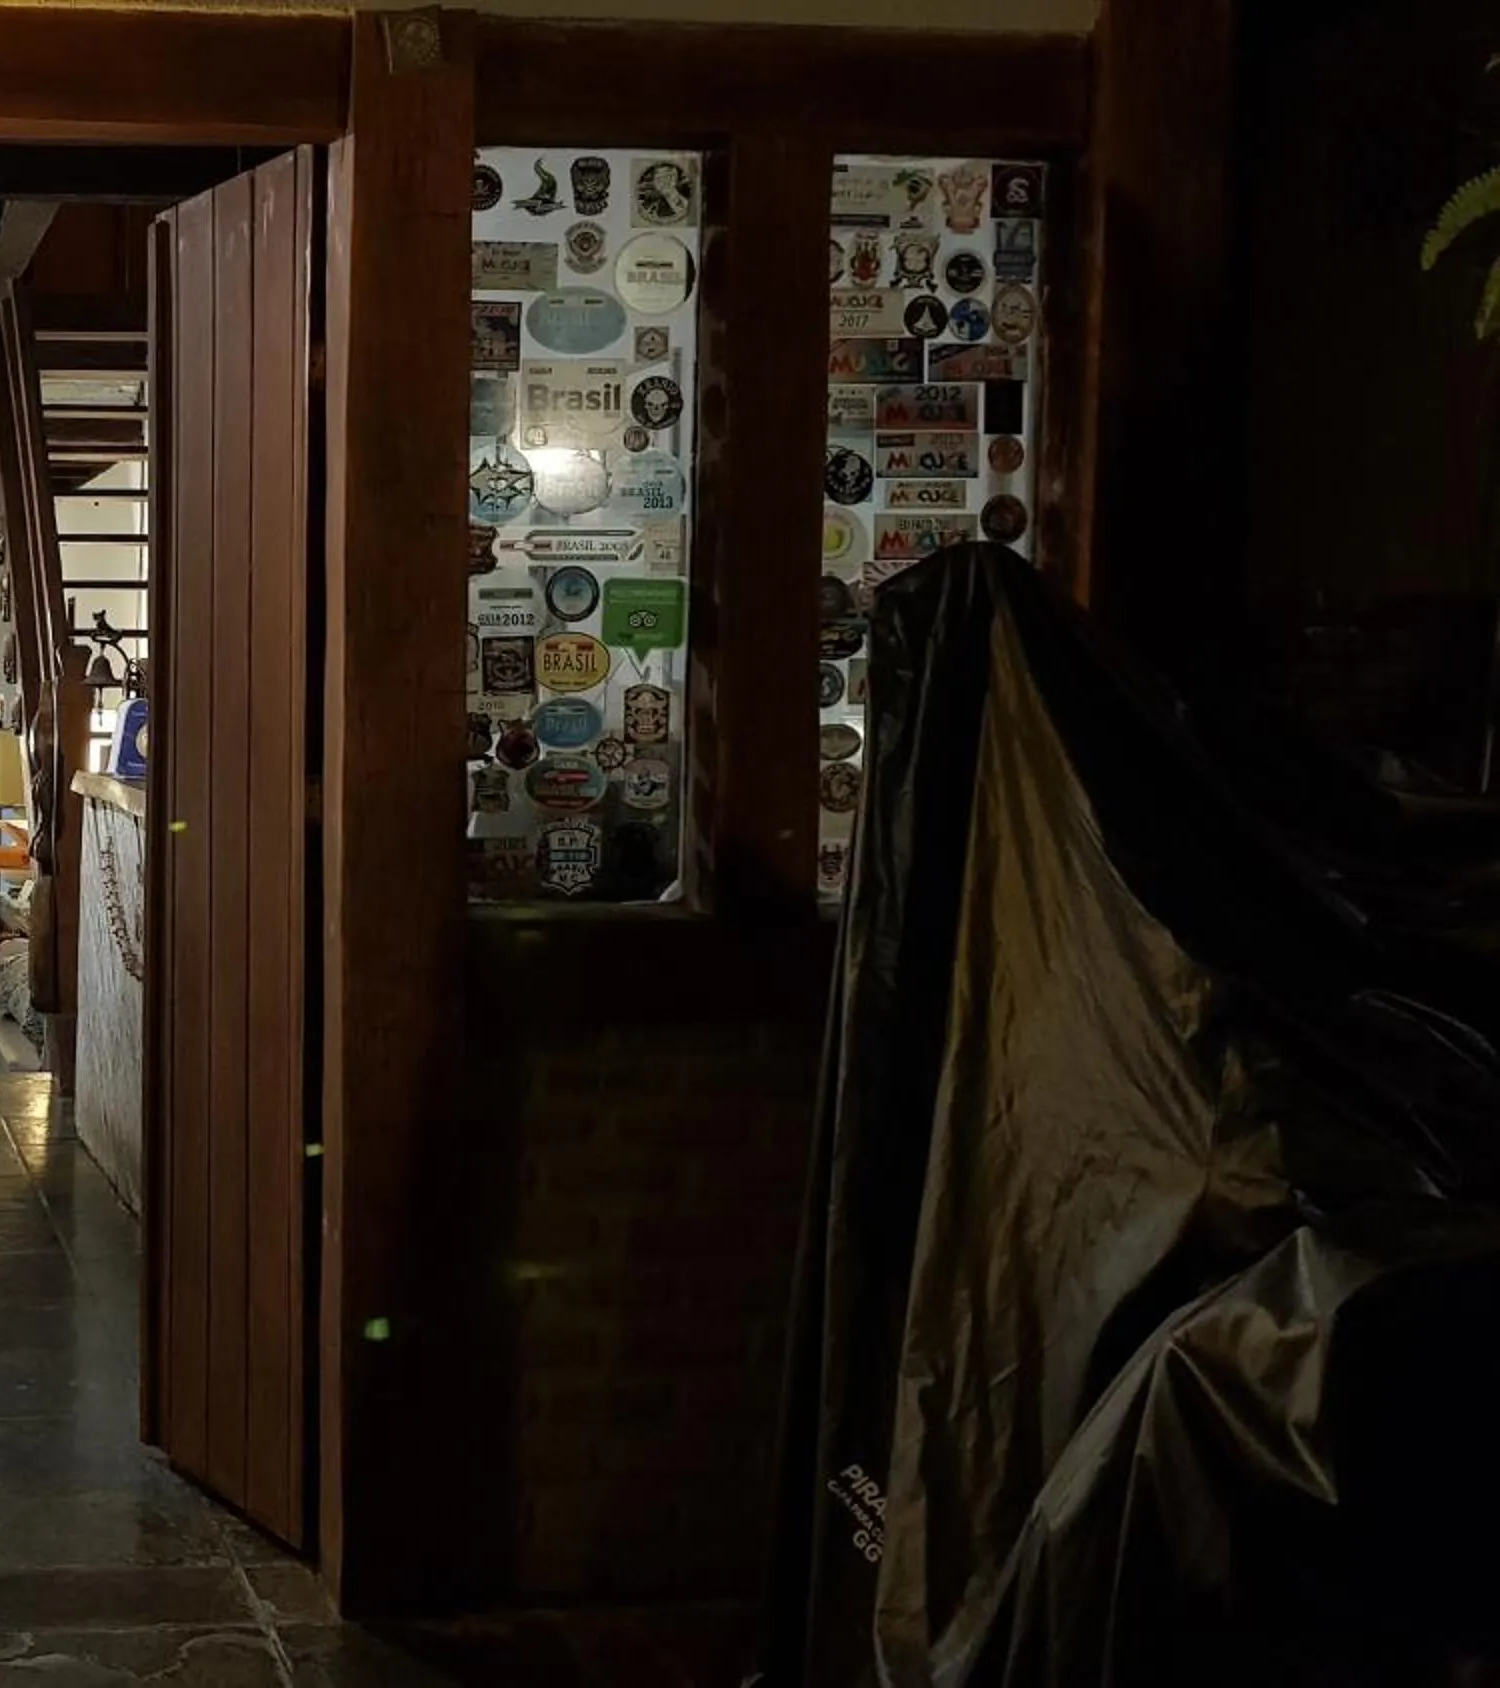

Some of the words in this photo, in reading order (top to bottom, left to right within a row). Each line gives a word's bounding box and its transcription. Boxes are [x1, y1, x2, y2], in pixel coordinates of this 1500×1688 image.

[527, 382, 621, 412] Brasil
[915, 386, 961, 401] 2012
[643, 496, 673, 509] 2013
[501, 613, 534, 626] 2012
[543, 652, 597, 673] BRASIL
[851, 1529, 884, 1563] GG
